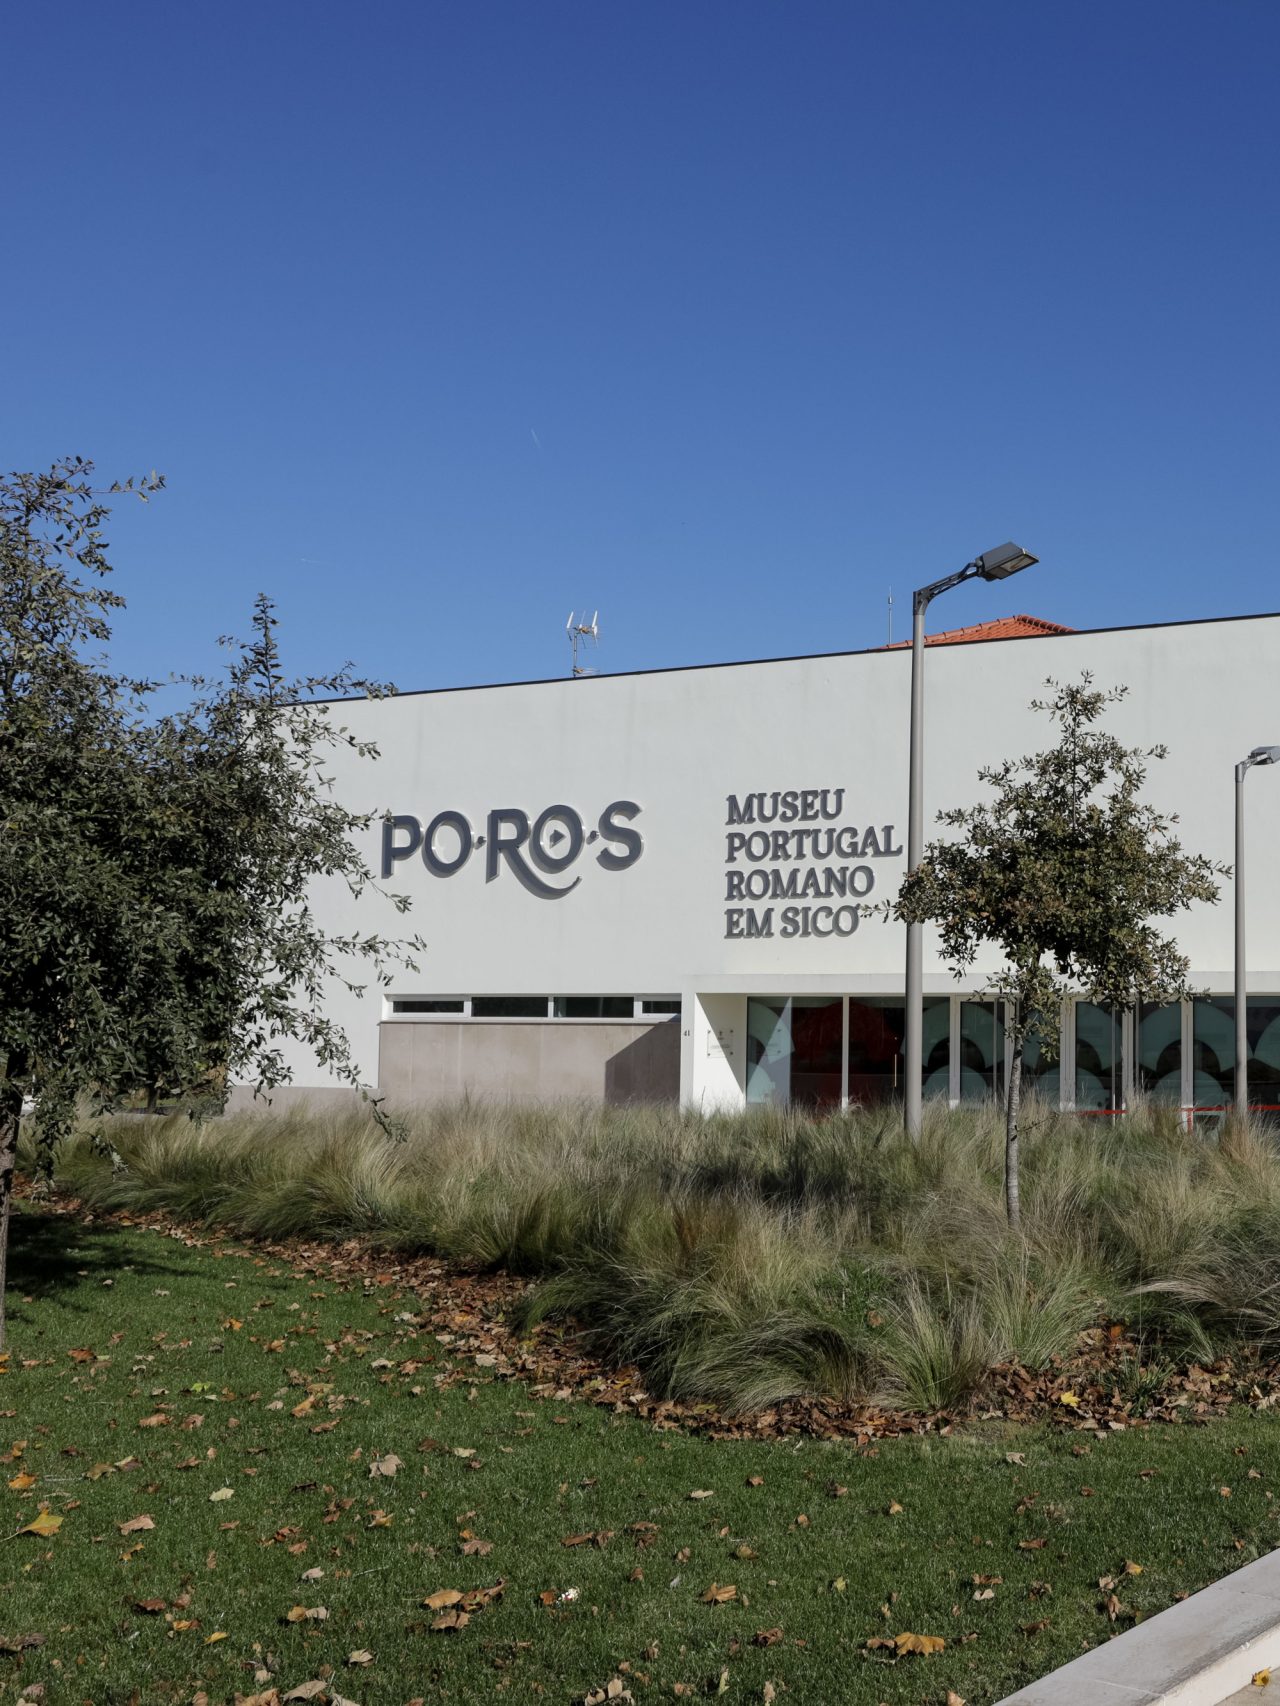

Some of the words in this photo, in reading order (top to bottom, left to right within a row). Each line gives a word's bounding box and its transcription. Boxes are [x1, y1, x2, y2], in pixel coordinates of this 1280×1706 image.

[725, 788, 845, 825] MUSEU
[725, 825, 903, 863] PORTUGAL
[724, 865, 875, 901] ROMANO
[724, 907, 775, 939] EM
